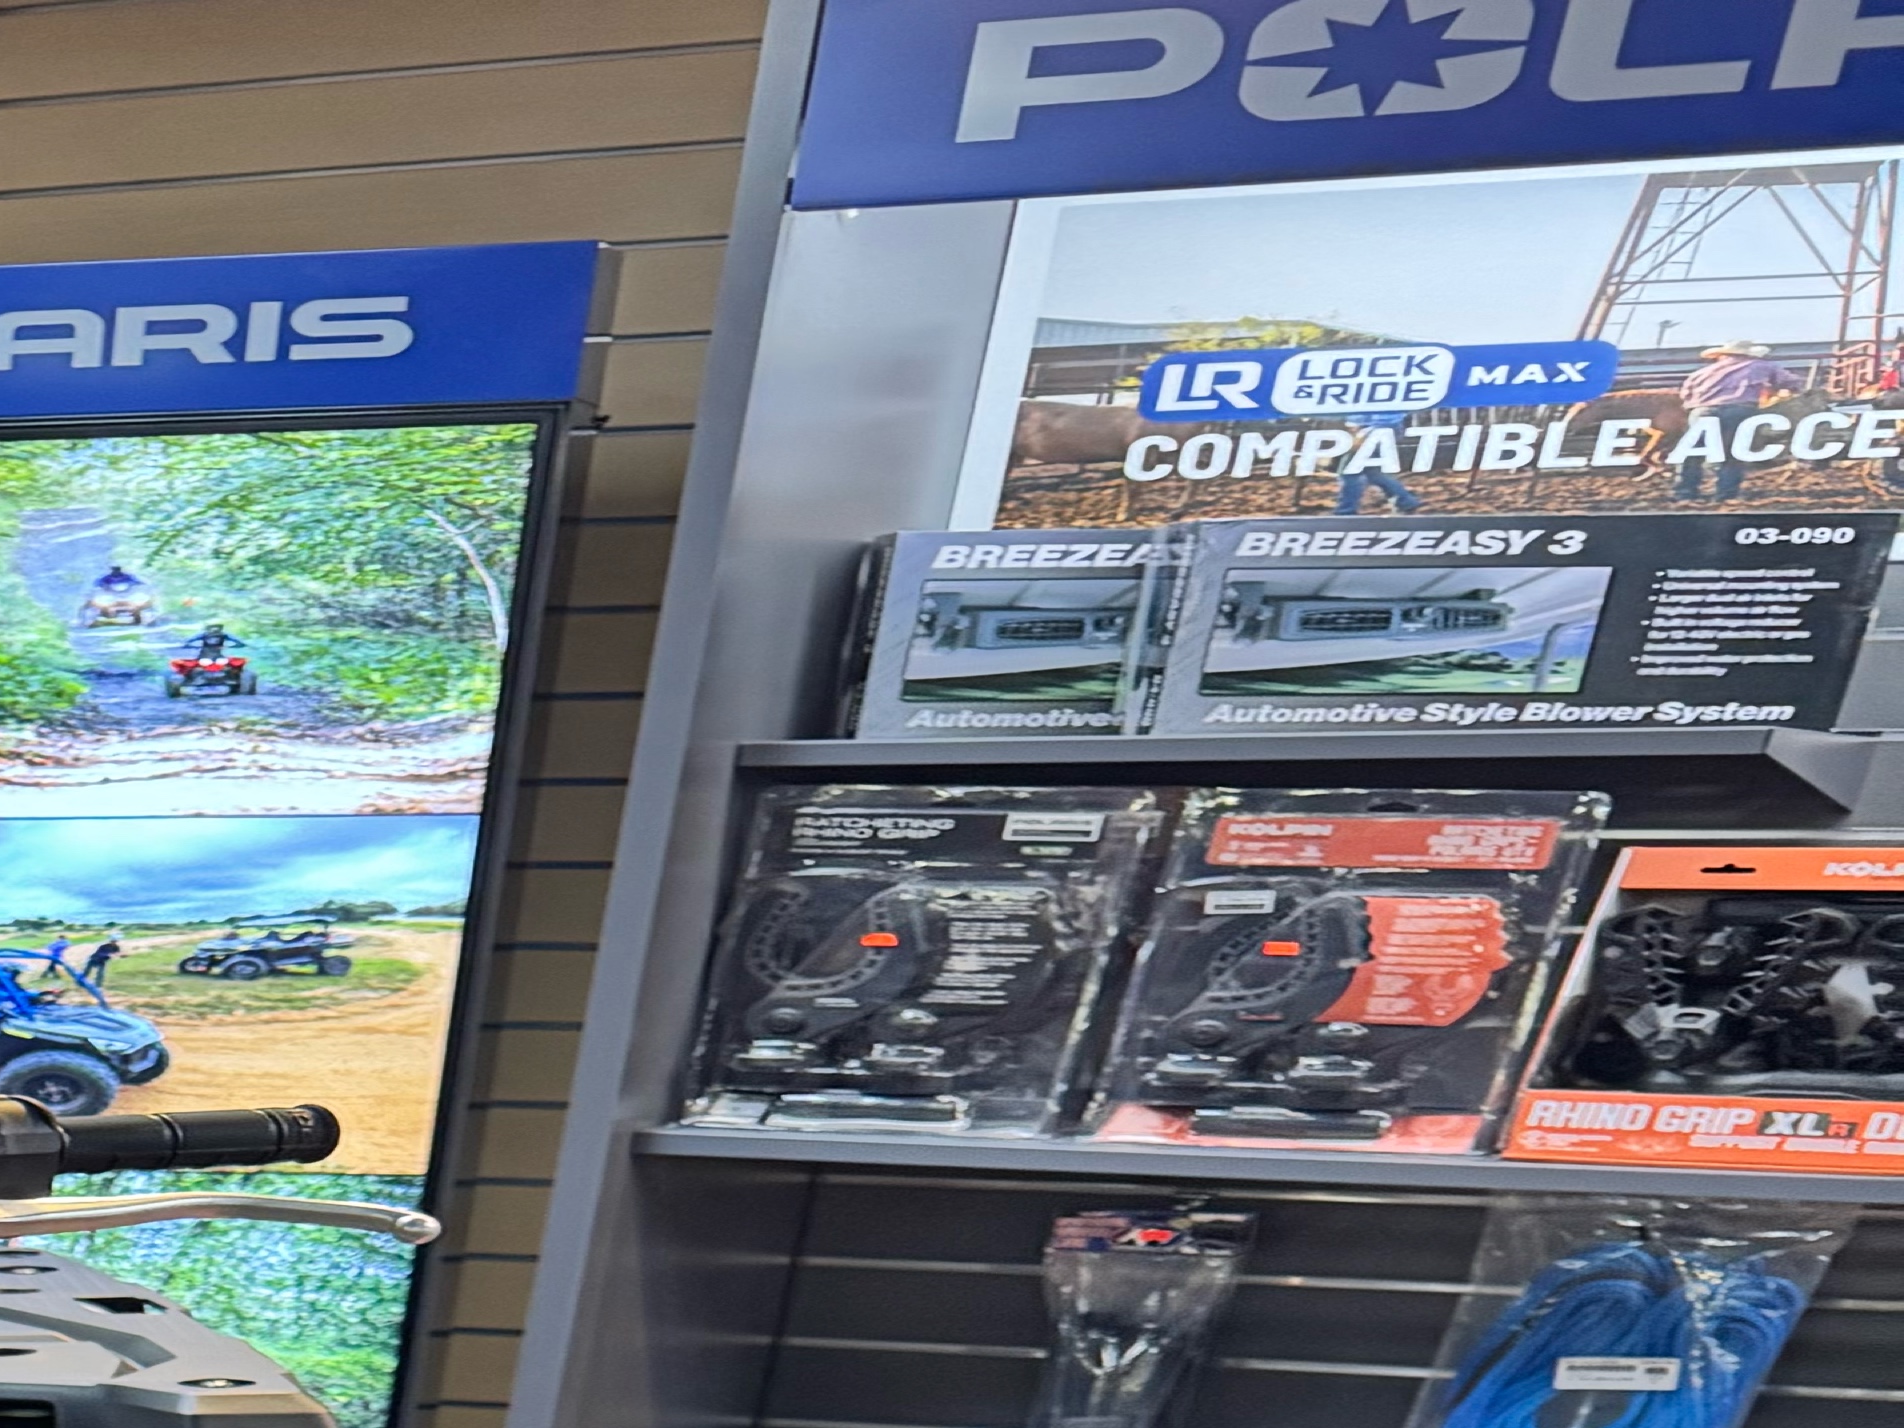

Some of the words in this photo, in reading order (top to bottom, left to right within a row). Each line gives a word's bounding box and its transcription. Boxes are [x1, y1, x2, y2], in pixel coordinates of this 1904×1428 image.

[1298, 353, 1440, 381] LOCK
[1466, 361, 1591, 387] MAX
[1123, 416, 1652, 483] COMPATIBLE
[1235, 529, 1545, 558] BREEZEASY
[1548, 530, 1588, 556] 3
[1735, 526, 1856, 545] 03-090
[905, 708, 1114, 729] Automotive
[1203, 702, 1418, 725] Automotive
[1419, 702, 1519, 727] Style
[1518, 701, 1653, 723] Blower
[1652, 701, 1796, 725] System
[1526, 1099, 1654, 1131] RHINO
[1653, 1105, 1757, 1136] GRIP
